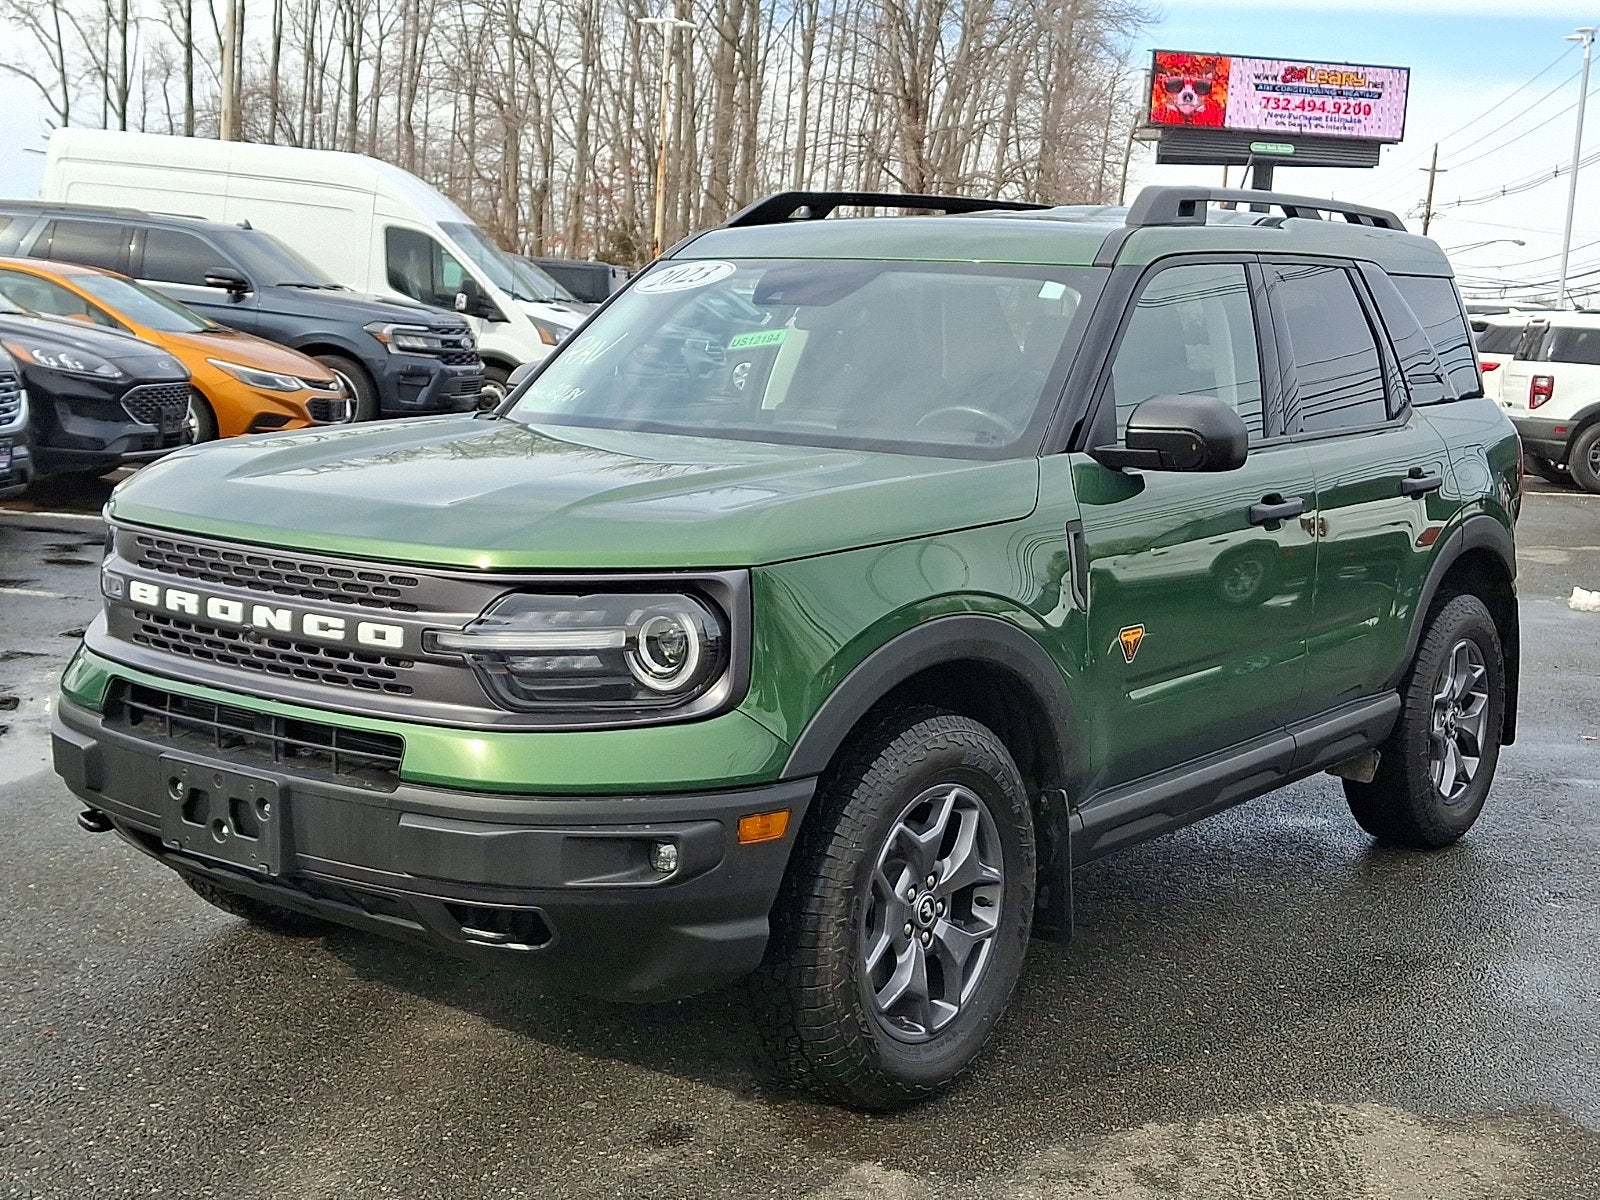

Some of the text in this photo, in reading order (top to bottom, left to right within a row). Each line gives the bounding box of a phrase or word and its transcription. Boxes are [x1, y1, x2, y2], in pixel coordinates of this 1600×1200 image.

[1261, 96, 1372, 116] 732.494.9200
[731, 333, 781, 347] US12194
[129, 580, 404, 648] BRONCO
